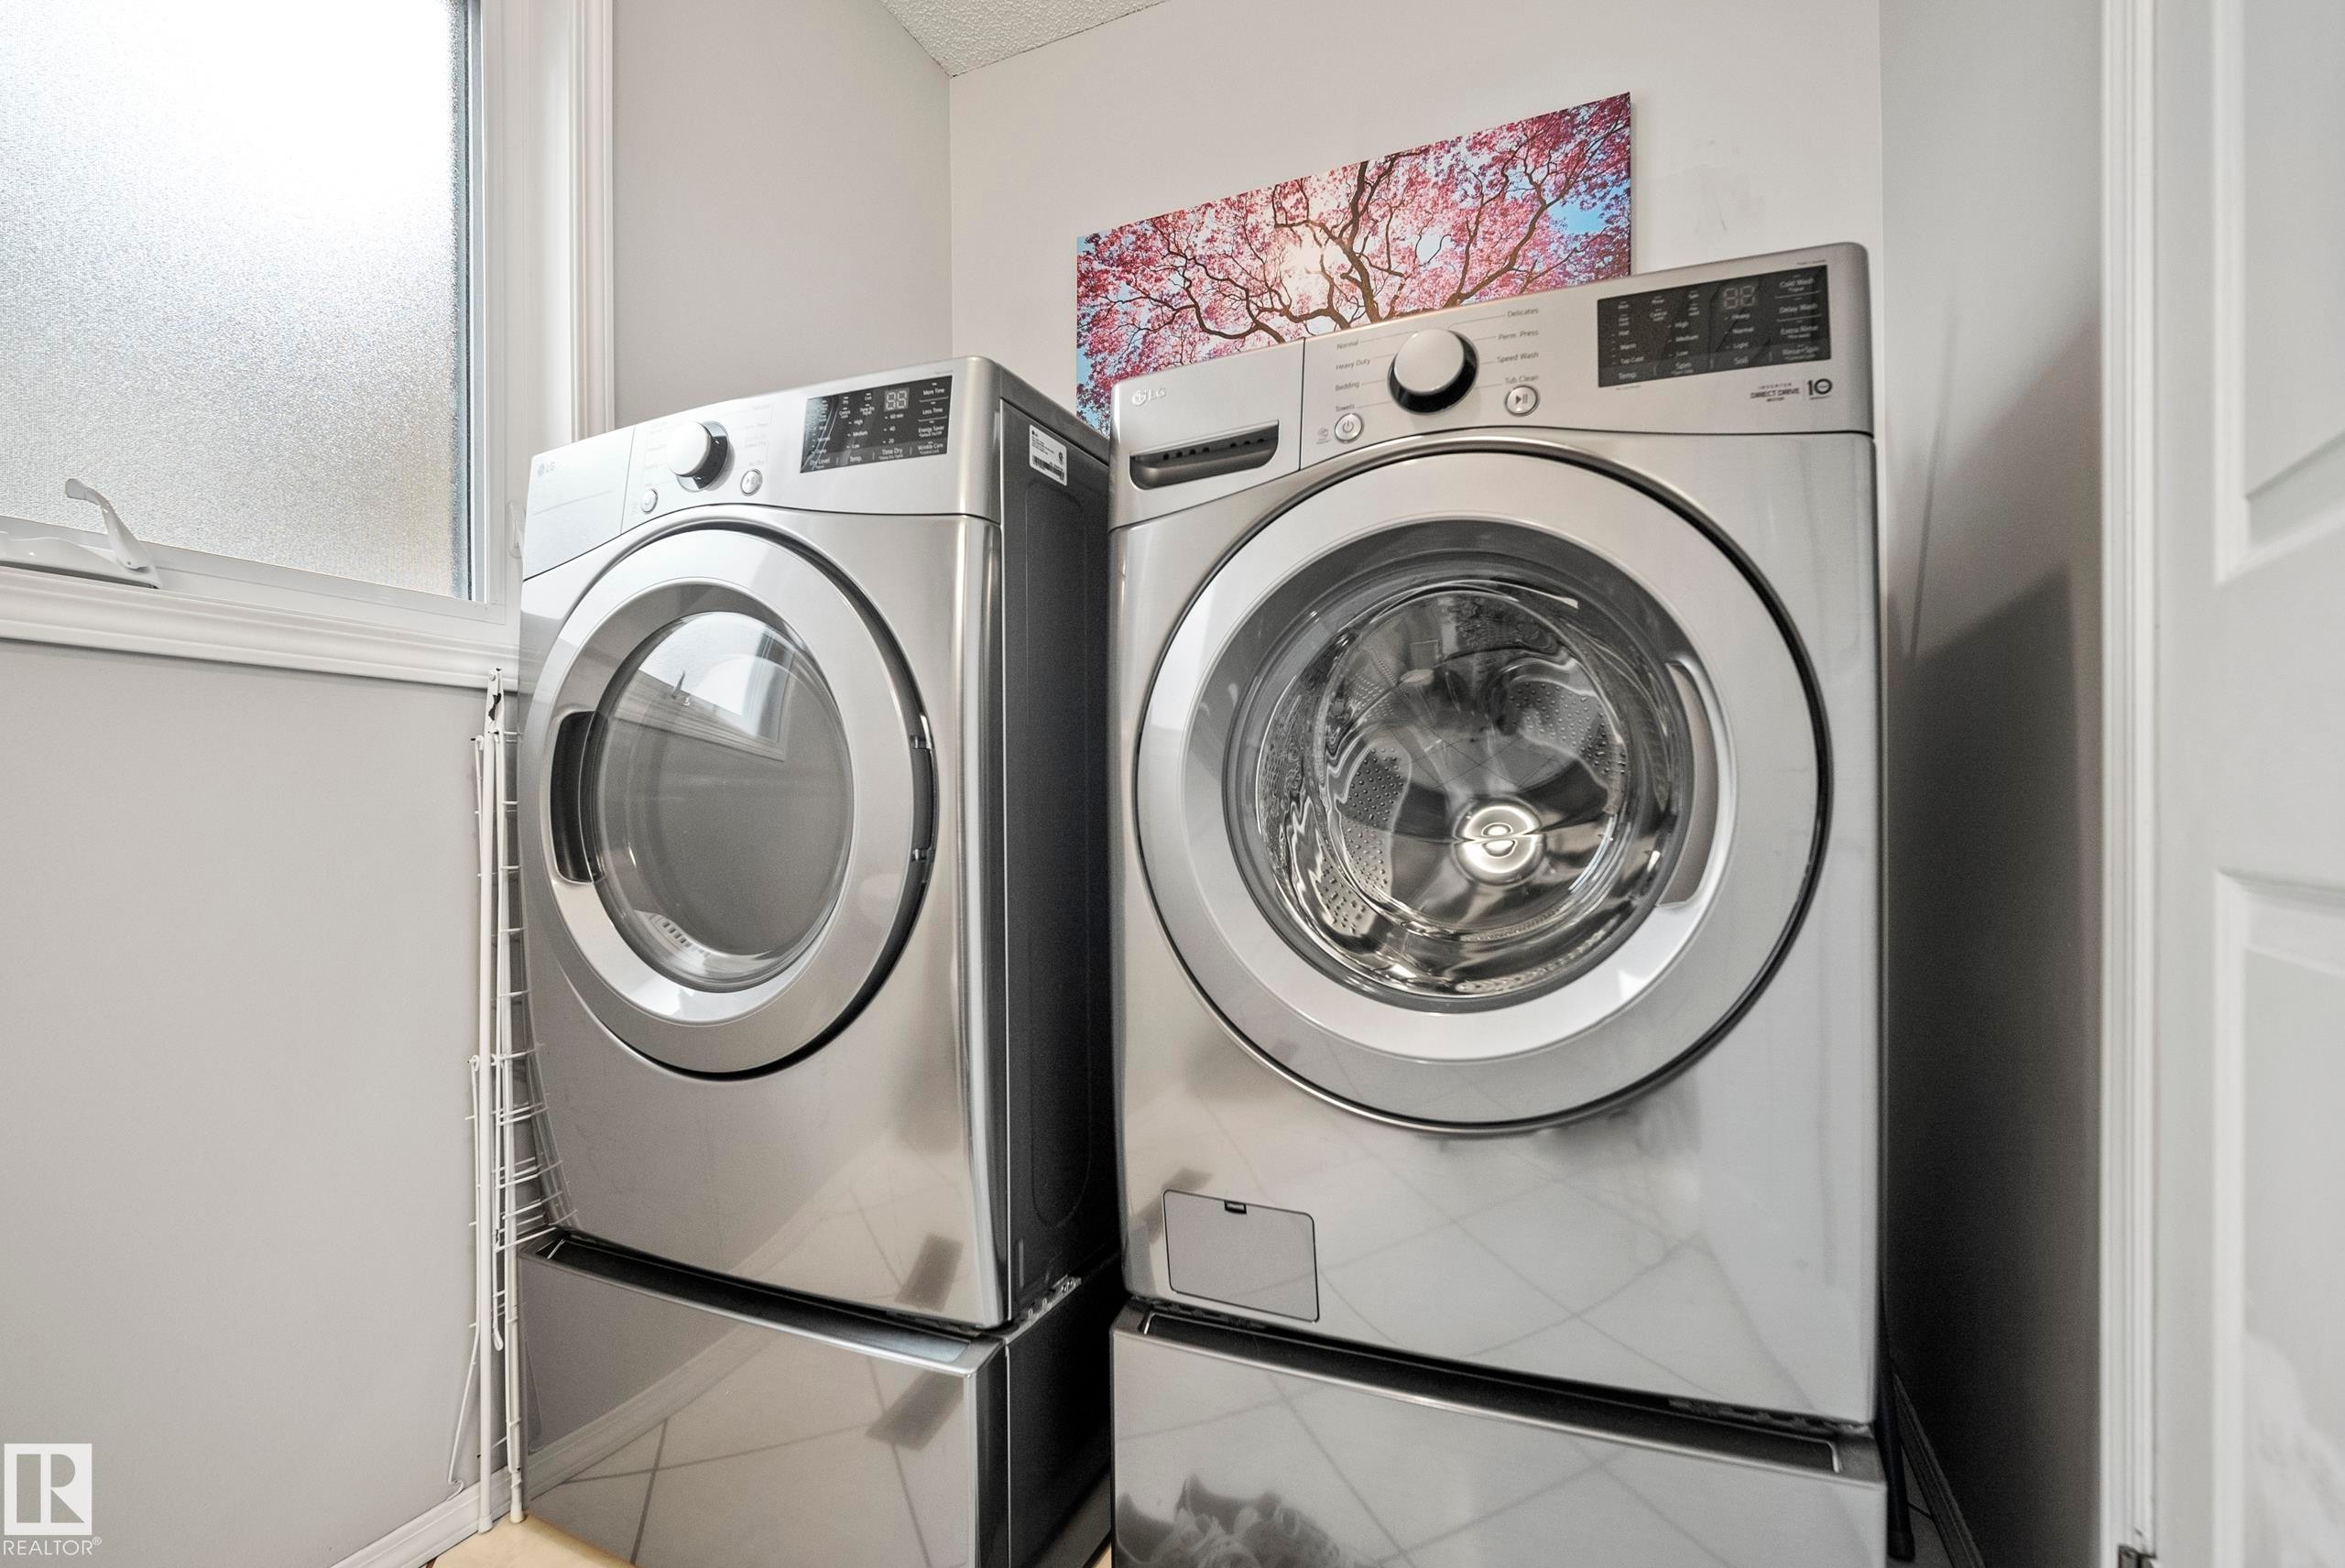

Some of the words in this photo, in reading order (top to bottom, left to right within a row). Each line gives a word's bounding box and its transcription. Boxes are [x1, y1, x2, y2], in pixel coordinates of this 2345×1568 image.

[1507, 308, 1539, 318] Delicates
[1336, 340, 1359, 349] Normal
[1497, 354, 1519, 363] Speed
[1336, 362, 1354, 370] Heavy
[1356, 358, 1370, 366] Duty
[1505, 376, 1517, 385] Tub
[1335, 381, 1360, 391] Bedding
[1808, 378, 1833, 396] 10
[1750, 389, 1776, 399] DIRECT
[1777, 387, 1800, 397] DRIVE
